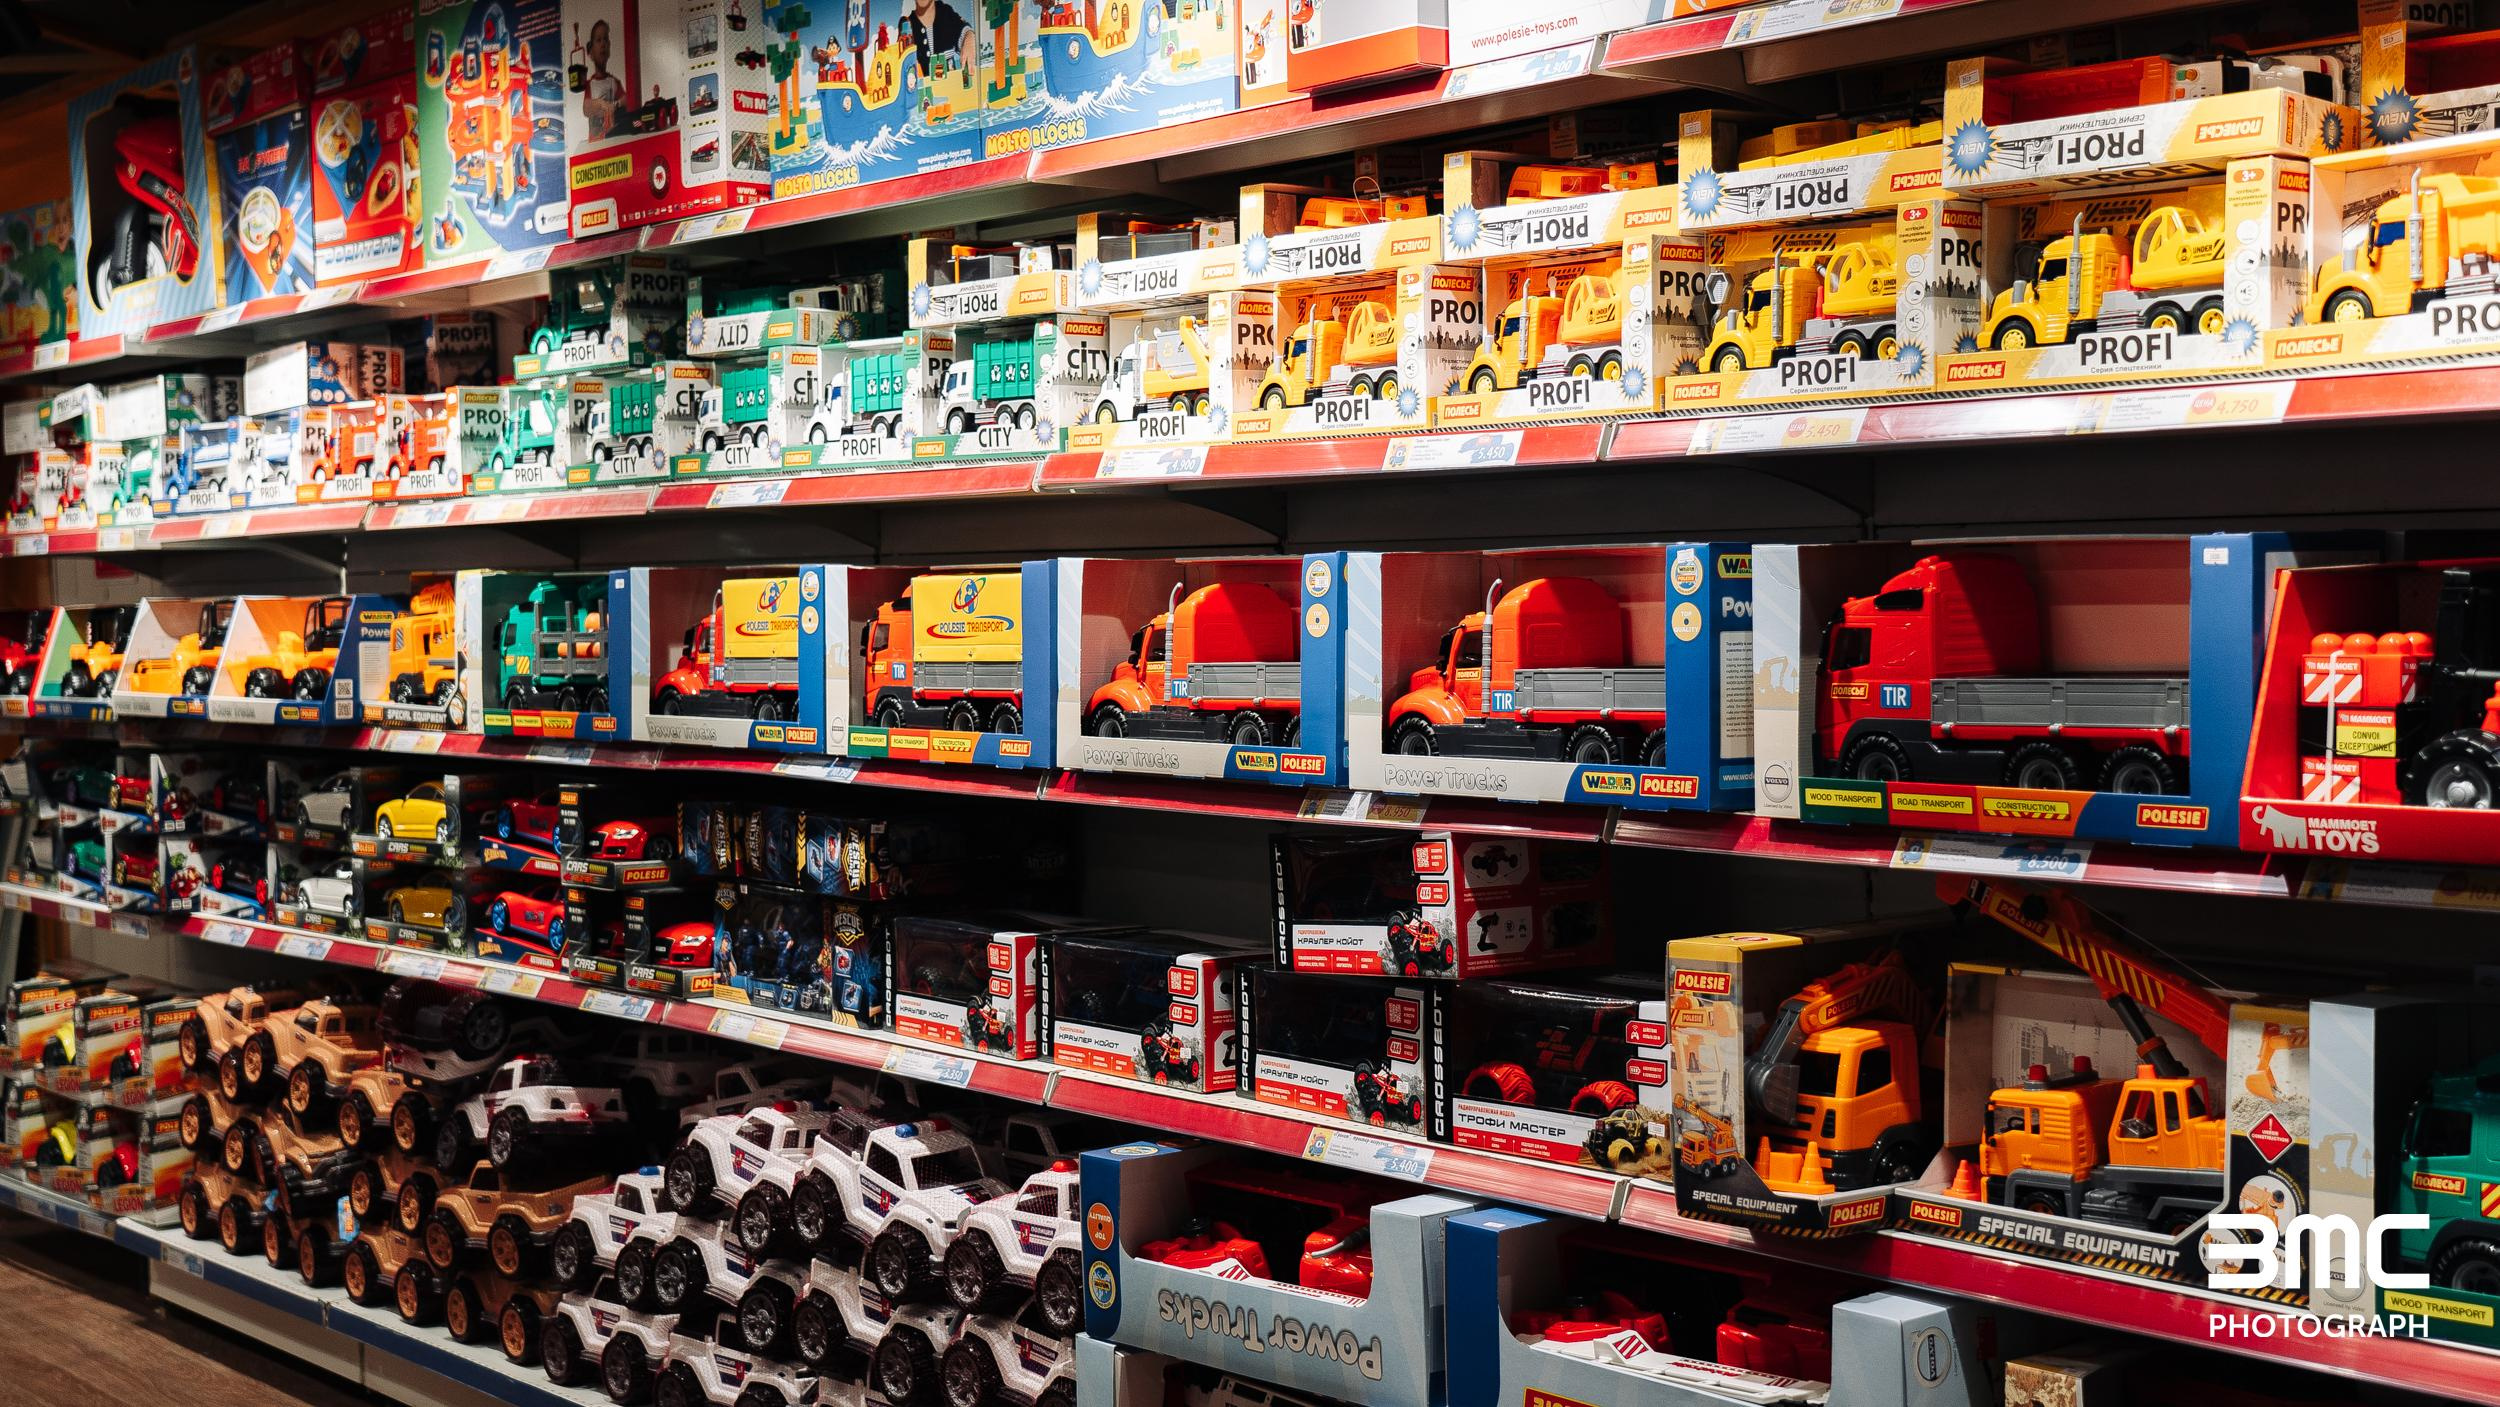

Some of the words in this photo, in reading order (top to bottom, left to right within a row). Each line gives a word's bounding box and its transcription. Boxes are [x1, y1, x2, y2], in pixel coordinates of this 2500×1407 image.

[1471, 16, 1578, 48] www.polesie-toys.com
[2059, 118, 2116, 132] СПЕЦТЕХНИКИ
[2118, 114, 2145, 124] СЕРИЯ
[2376, 110, 2410, 126] NEW
[986, 126, 1030, 157] MOLTO
[1032, 117, 1086, 149] BLOCKS
[2198, 118, 2262, 142] ПОЛЕСЬЕ
[1957, 141, 1986, 156] NEW
[2057, 129, 2144, 165] PROFI
[575, 158, 629, 183] CONSTRUCTION
[2241, 170, 2257, 182] 3+
[775, 175, 812, 198] MOLTO
[814, 164, 859, 188] BLOCKS
[1690, 187, 1715, 202] NEW
[1775, 179, 1849, 210] PROFI
[1909, 210, 1921, 219] 3+
[1527, 217, 1590, 244] PROFI
[1391, 237, 1430, 256] ПОЛЕСЬЕ
[1785, 238, 1823, 248] CONSTRUCTION
[1309, 243, 1362, 269] PROFI
[2193, 246, 2213, 256] UNDER
[631, 274, 687, 292] PROFI
[1135, 268, 1177, 290] PROFI
[1405, 275, 1416, 284] 3+
[1432, 277, 1473, 290] ПОЛЕСЬЕ
[959, 291, 998, 315] PROFI
[439, 326, 489, 341] PROFI
[717, 323, 749, 346] CITY
[1066, 323, 1104, 334] ПОЛЕСЬЕ
[564, 345, 596, 362] PROFI
[2080, 333, 2172, 366] PROFI
[2276, 338, 2340, 356] ПОЛЕСЬЕ
[1781, 356, 1856, 387] PROFI
[1948, 361, 2005, 380] ПОЛЕСЬЕ
[2091, 366, 2114, 374] Серия
[2116, 363, 2162, 372] спецтехники
[1530, 379, 1590, 407] PROFI
[1675, 384, 1719, 399] ПОЛЕСЬЕ
[1790, 386, 1808, 394] Серия
[1810, 385, 1848, 394] спецтехники
[1315, 399, 1369, 424] PROFI
[1445, 404, 1480, 418] ПОЛЕСЬЕ
[2217, 400, 2258, 415] 4.750
[1140, 415, 1185, 438] PROFI
[1238, 420, 1270, 432] ПОЛЕСЬЕ
[1789, 424, 1805, 432] ЦЕНА
[1806, 424, 1840, 438] 5.450
[978, 426, 1011, 447] CITY
[842, 439, 881, 456] PROFI
[725, 446, 751, 465] CITY
[612, 455, 638, 475] CITY
[514, 464, 543, 482] PROFI
[336, 477, 363, 492] PROFI
[410, 474, 436, 489] PROFI
[410, 474, 436, 489] PROFI
[190, 493, 216, 506] PROFI
[939, 620, 965, 634] POLESIE
[967, 619, 1004, 633] TRANSPORT
[893, 664, 905, 679] TIR
[1173, 680, 1188, 696] TIR
[1494, 693, 1513, 710] TIR
[1883, 686, 1907, 707] TIR
[387, 709, 410, 720] SPECIAL
[411, 712, 447, 723] EQUIPMENT
[2350, 715, 2393, 723] MAMMOET
[648, 724, 679, 740] Power
[681, 726, 717, 741] Trucks
[757, 727, 783, 739] WADER
[788, 730, 816, 742] POLESIE
[2352, 731, 2380, 740] CONVOI
[893, 737, 905, 746] ROAD
[938, 738, 966, 747] CONSTRUCTION
[1001, 741, 1029, 755] POLESIE
[1083, 746, 1129, 766] Power
[1130, 750, 1180, 769] Trucks
[1237, 752, 1275, 763] WADER
[1283, 757, 1325, 773] POLESIE
[1384, 764, 1442, 788] Power
[1445, 767, 1507, 792] Trucks
[1585, 775, 1632, 787] WADER
[1642, 777, 1694, 797] POLESIE
[1810, 792, 1832, 801] WOOD
[1833, 794, 1876, 804] TRANSPORT
[1897, 797, 1914, 806] ROAD
[1916, 799, 1965, 809] TRANSPORT
[1384, 805, 1411, 817] 8.950
[1996, 802, 2056, 812] CONSTRUCTION
[2141, 808, 2202, 826] POLESIE
[2308, 818, 2377, 831] MAMMOET
[388, 842, 409, 853] CARS
[2310, 830, 2380, 854] TOYS
[567, 861, 588, 872] CARS
[850, 832, 859, 888] RESCUE
[2028, 854, 2068, 869] 8.500
[627, 870, 665, 879] POLESIE
[1274, 847, 1287, 966] CROSSBOT
[305, 913, 322, 923] CARS
[834, 913, 861, 932] RESCUE
[399, 929, 417, 940] CARS
[1336, 936, 1364, 945] КОЙОТ
[574, 957, 596, 971] CARS
[632, 966, 655, 979] CARS
[1677, 973, 1726, 991] POLESIE
[900, 1006, 927, 1015] КРАУЛЕР
[929, 1011, 949, 1020] КОЙОТ
[1682, 1013, 1703, 1023] POLESIE
[1059, 1033, 1092, 1044] КРАУЛЕР
[1094, 1039, 1119, 1049] КОЙОТ
[1435, 989, 1445, 1136] CROSSBOT
[1261, 1067, 1298, 1080] КРАУЛЕР
[1301, 1075, 1329, 1087] КОЙОТ
[1458, 1113, 1505, 1128] ТРОФИ
[1510, 1121, 1566, 1136] МАСТЕР
[2262, 1128, 2279, 1136] UNDER
[2251, 1134, 2290, 1143] CONSTRUCTION
[1390, 1161, 1418, 1173] 5.400
[2415, 1174, 2463, 1191] ПОЛЕСЬЕ
[1692, 1189, 1734, 1206] SPECIAL
[1736, 1195, 1798, 1214] EQUIPMENT
[1089, 1212, 1111, 1222] QUALITY
[1834, 1201, 1880, 1223] POLESIE
[1913, 1205, 1957, 1223] POLESIE
[1978, 1216, 2056, 1246] SPECIAL
[2062, 1231, 2180, 1268] EQUIPMENT
[2390, 1296, 2423, 1311] WOOD
[2426, 1302, 2486, 1320] TRANSPORT
[1158, 1288, 1265, 1354] Trucks
[1269, 1315, 1383, 1381] Power
